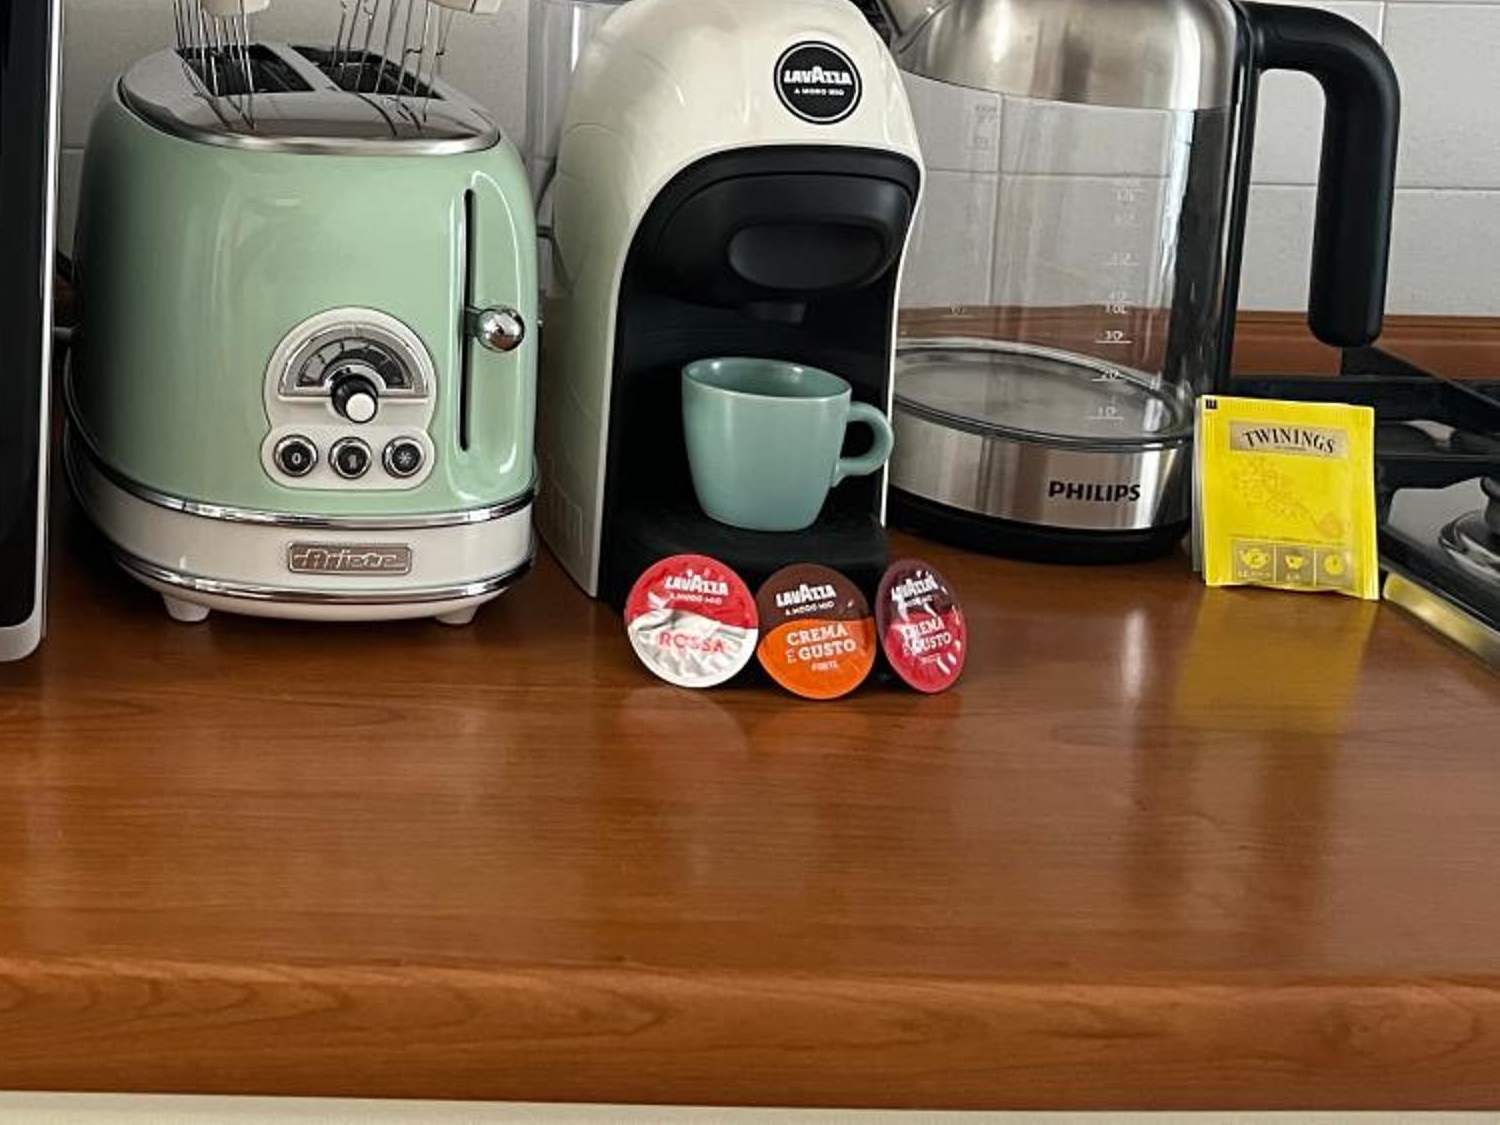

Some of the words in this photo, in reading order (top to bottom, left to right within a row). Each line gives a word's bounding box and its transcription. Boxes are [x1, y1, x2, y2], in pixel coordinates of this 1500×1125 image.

[783, 66, 852, 86] LAVAZZA
[1242, 428, 1335, 454] TWININGS
[1048, 480, 1140, 503] PHILIPS
[664, 574, 729, 596] LAVAZZA
[776, 584, 836, 607] LAVAZZA
[659, 631, 725, 654] ROSSA
[787, 623, 848, 646] CREMA
[798, 638, 856, 661] GUSTO
